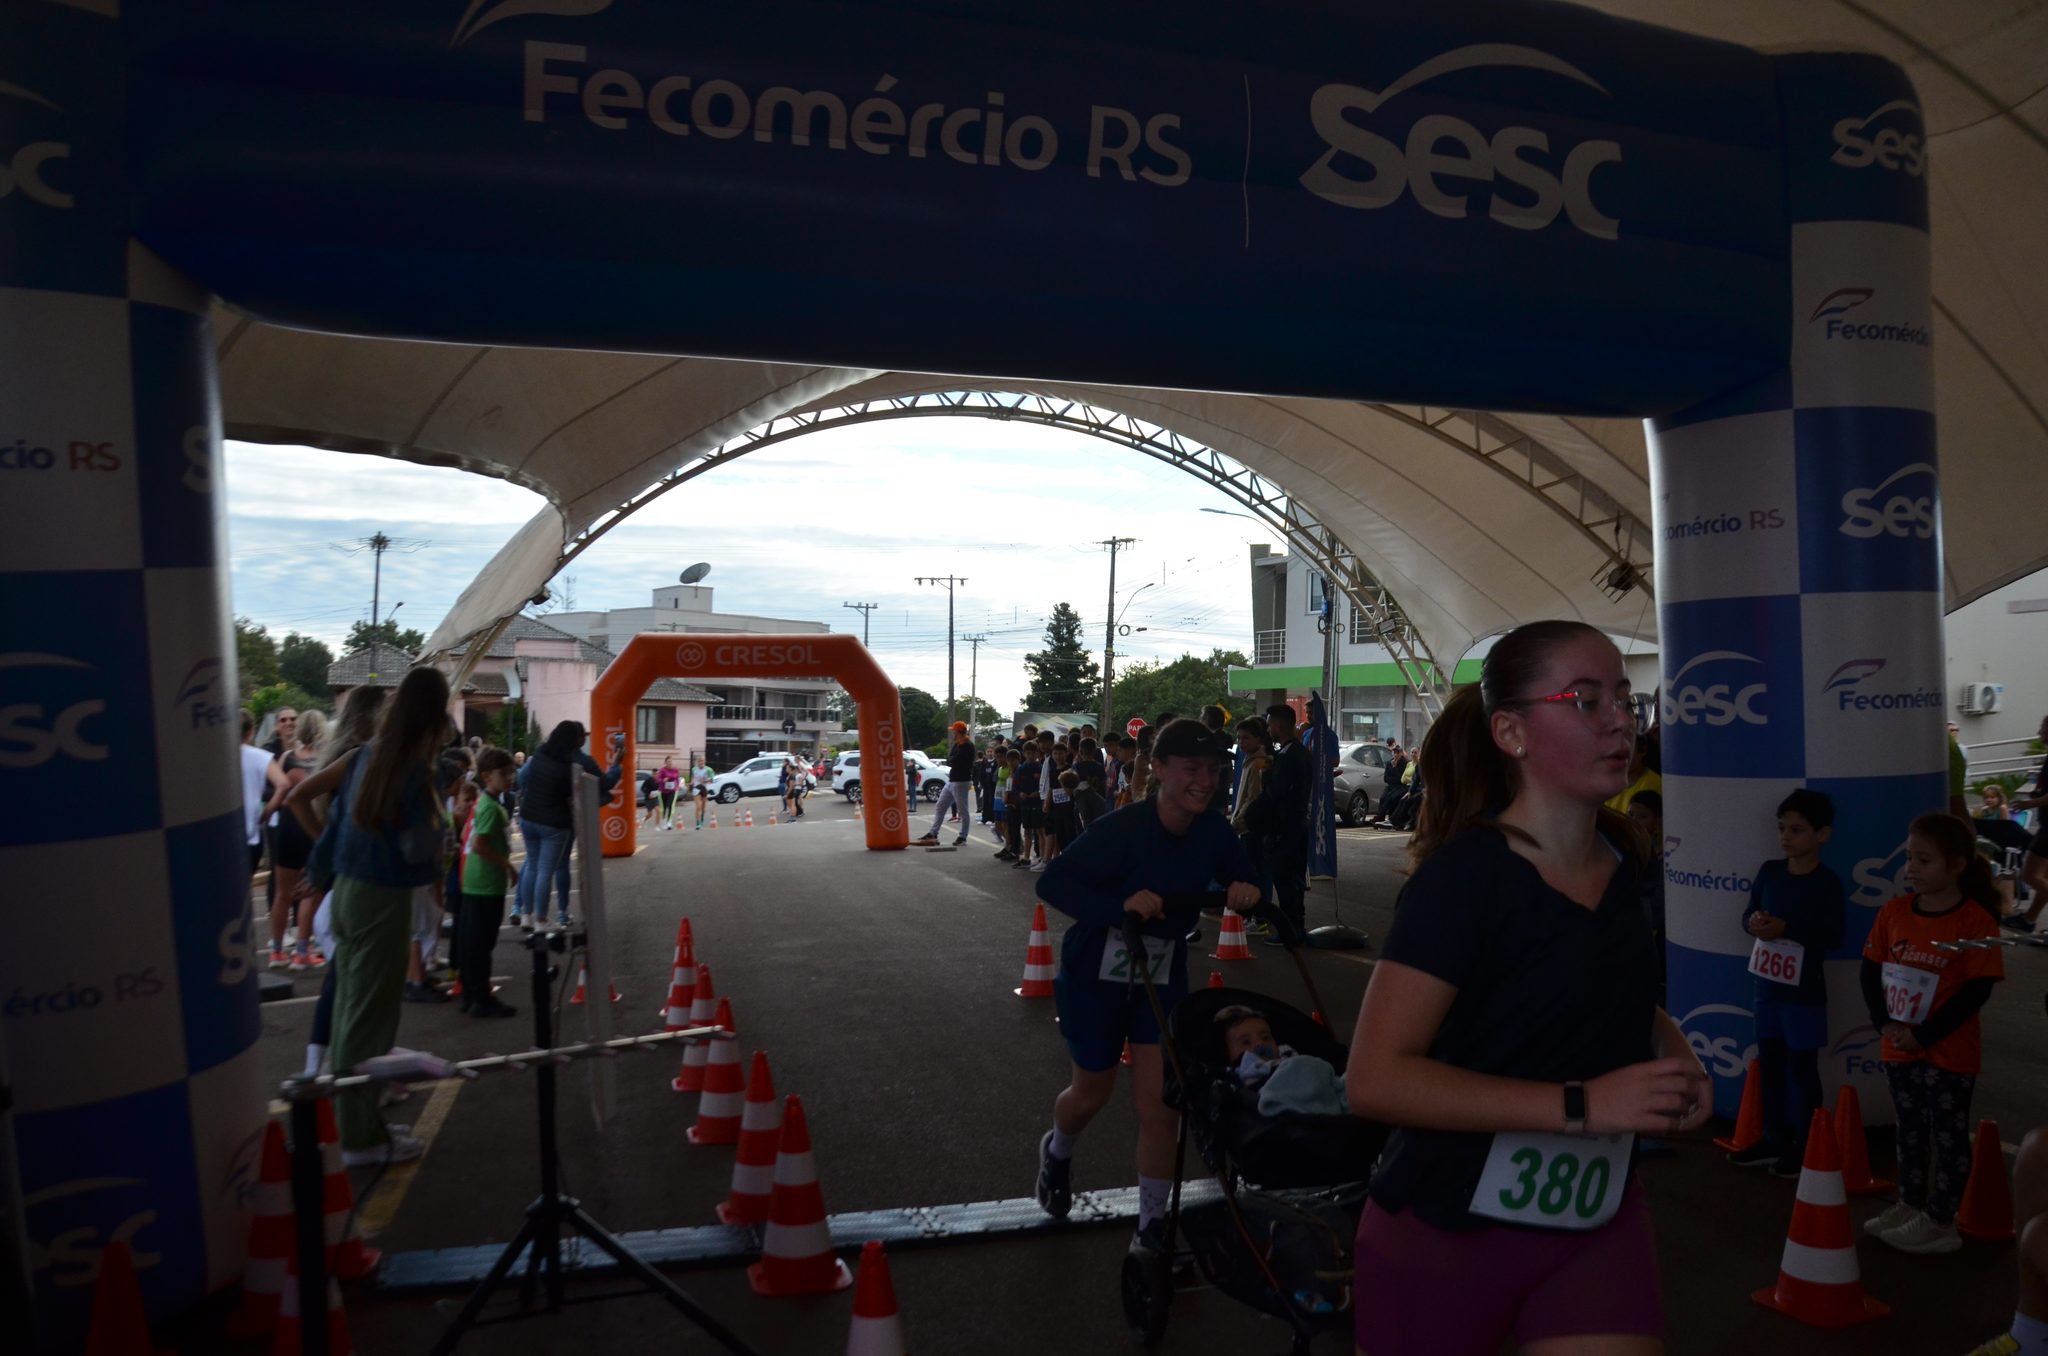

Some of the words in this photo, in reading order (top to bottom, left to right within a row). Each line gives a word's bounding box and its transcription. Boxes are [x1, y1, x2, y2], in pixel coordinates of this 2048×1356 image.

[523, 39, 1058, 171] Fecomércio
[1086, 105, 1193, 187] RS
[1300, 82, 1623, 241] Sesc
[69, 441, 121, 472] RS
[1749, 508, 1786, 531] RS
[715, 644, 821, 667] CRESOL
[877, 713, 898, 801] CRESOL
[1109, 949, 1166, 979] 27
[1753, 946, 1796, 980] 1266
[113, 966, 164, 1004] RS
[1500, 1146, 1610, 1219] 380
